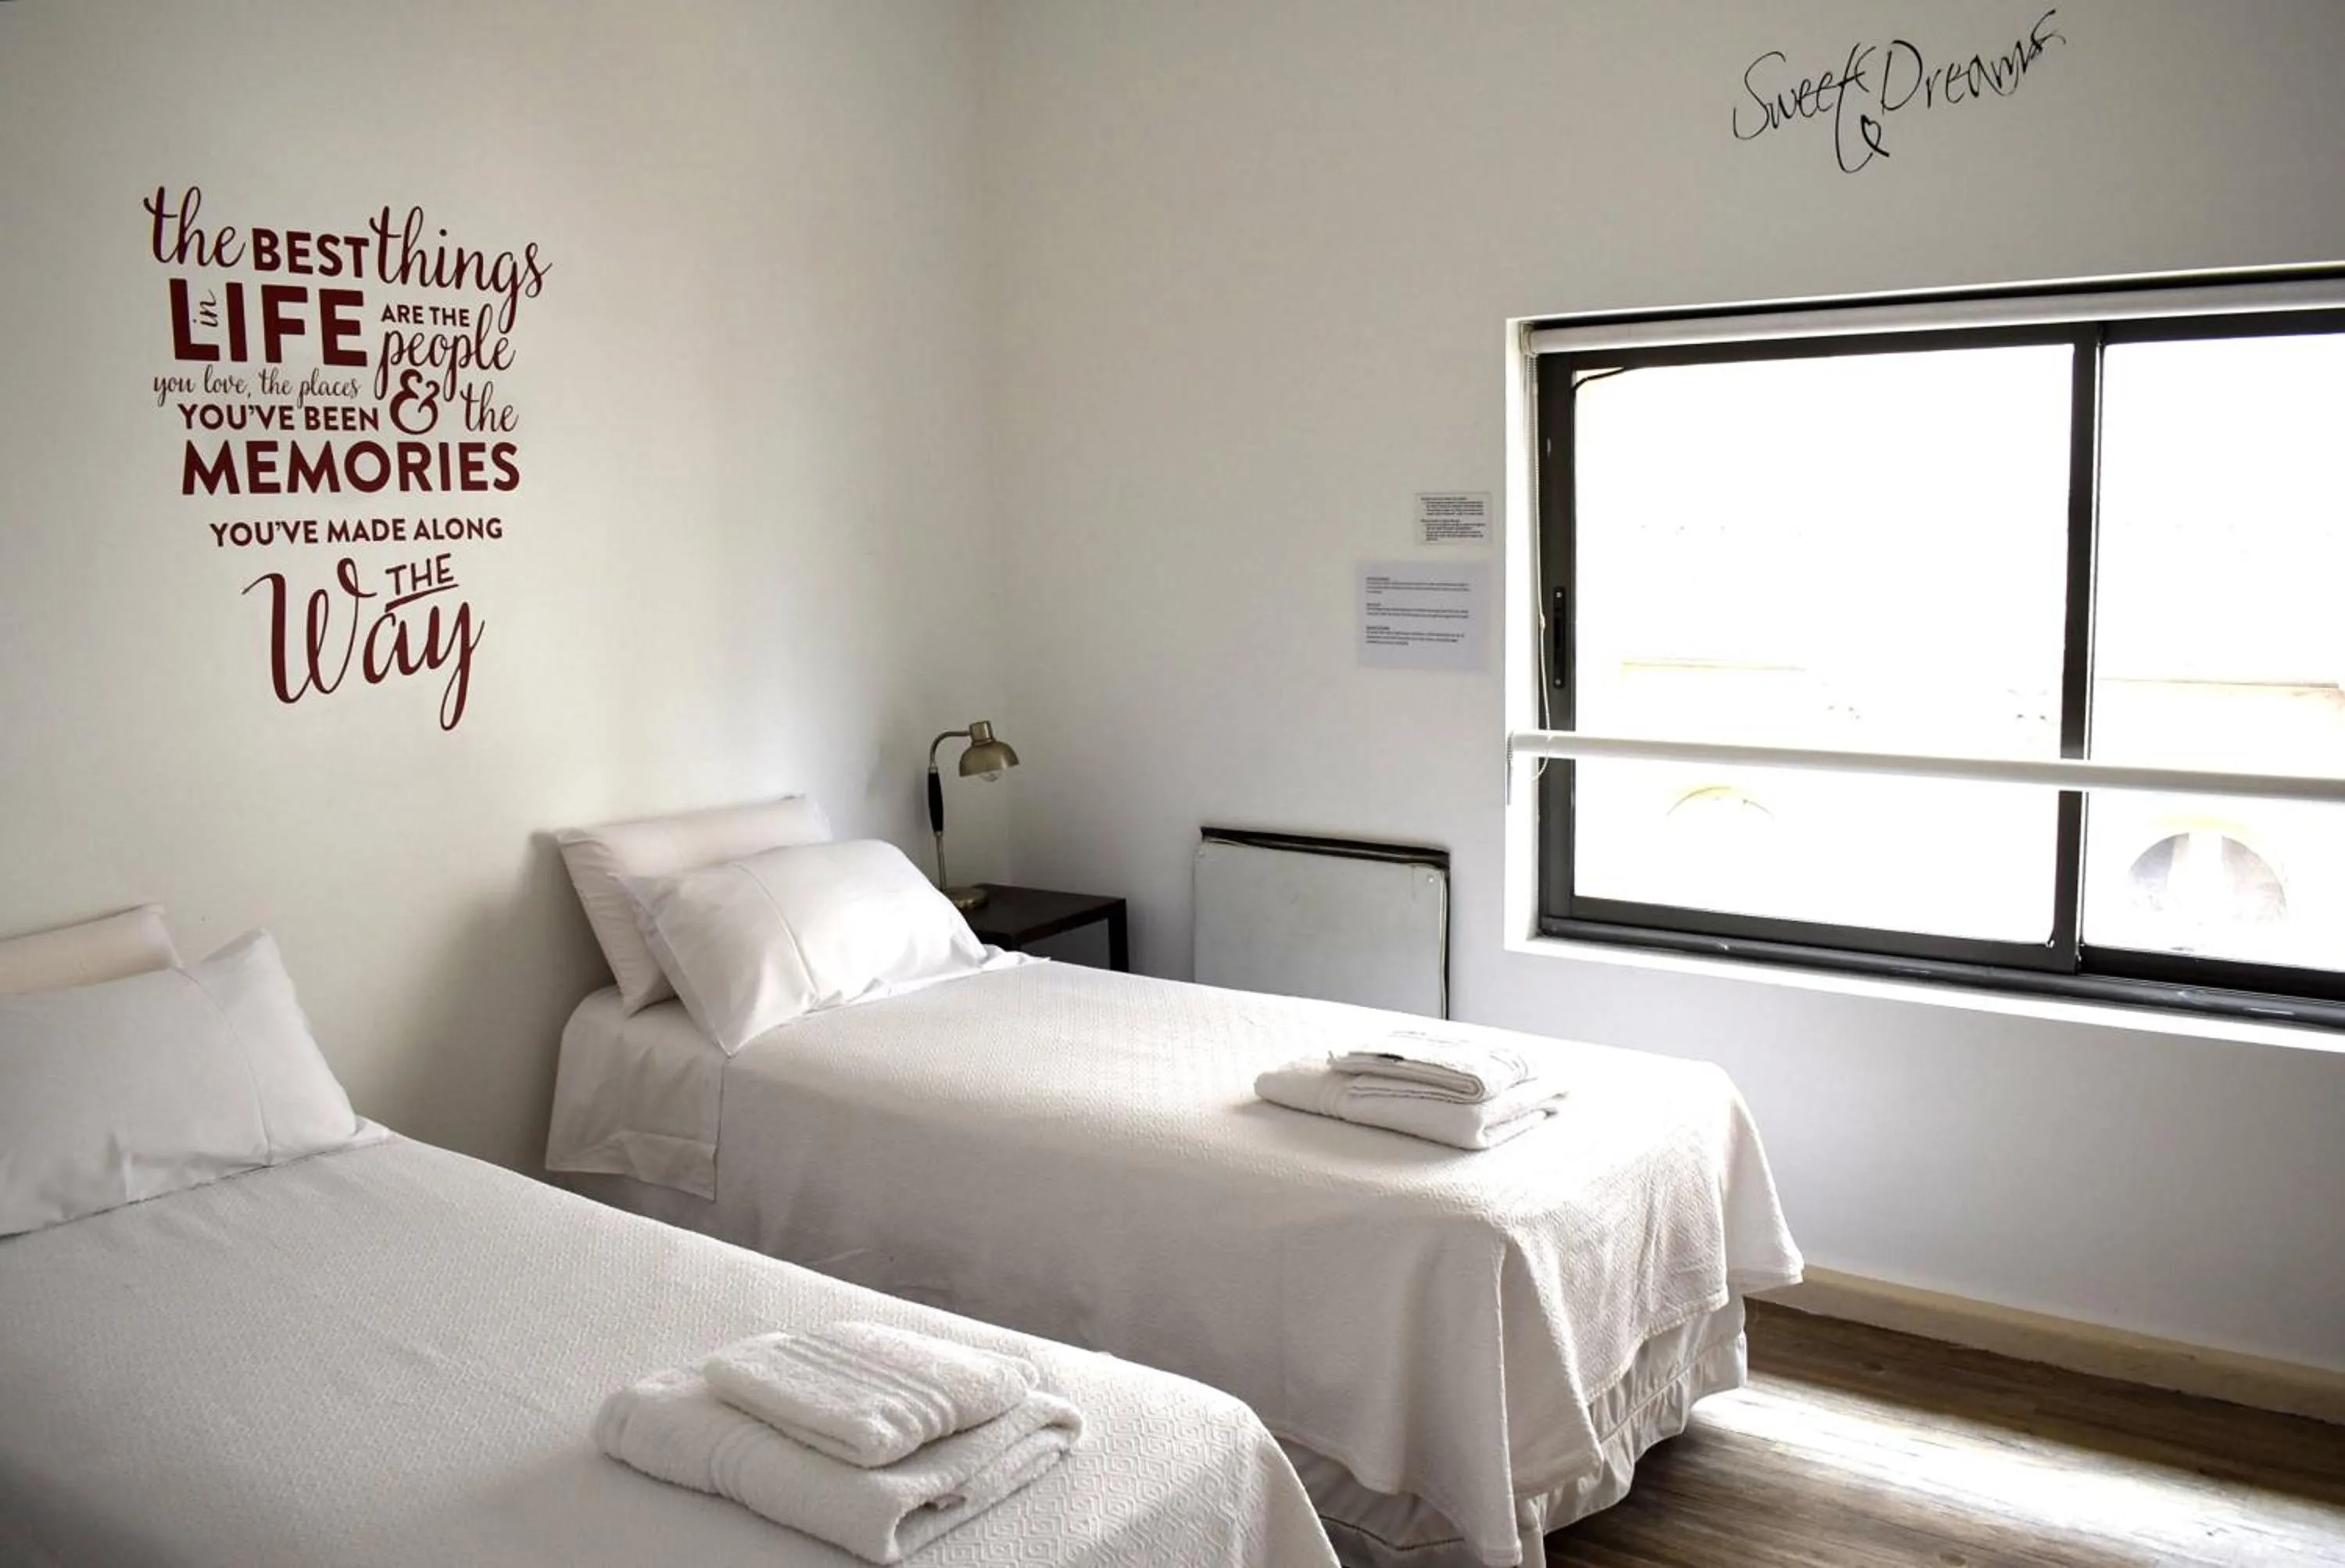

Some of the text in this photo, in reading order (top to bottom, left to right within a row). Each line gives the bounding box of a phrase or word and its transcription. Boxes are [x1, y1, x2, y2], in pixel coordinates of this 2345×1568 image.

[1733, 9, 2066, 174] Sweet Dreams
[143, 186, 553, 334] the BEST things
[169, 278, 368, 367] LIFE
[192, 289, 218, 329] in
[381, 303, 471, 328] ARE THE
[374, 303, 516, 402] people
[154, 363, 361, 410] you love, the places
[390, 369, 518, 435] & the
[177, 403, 380, 432] YOU'VE BEEN
[181, 440, 521, 496] MEMORIES
[209, 517, 503, 547] YOU'VE MADE ALONG
[385, 553, 455, 596] THE
[242, 557, 485, 731] Way
